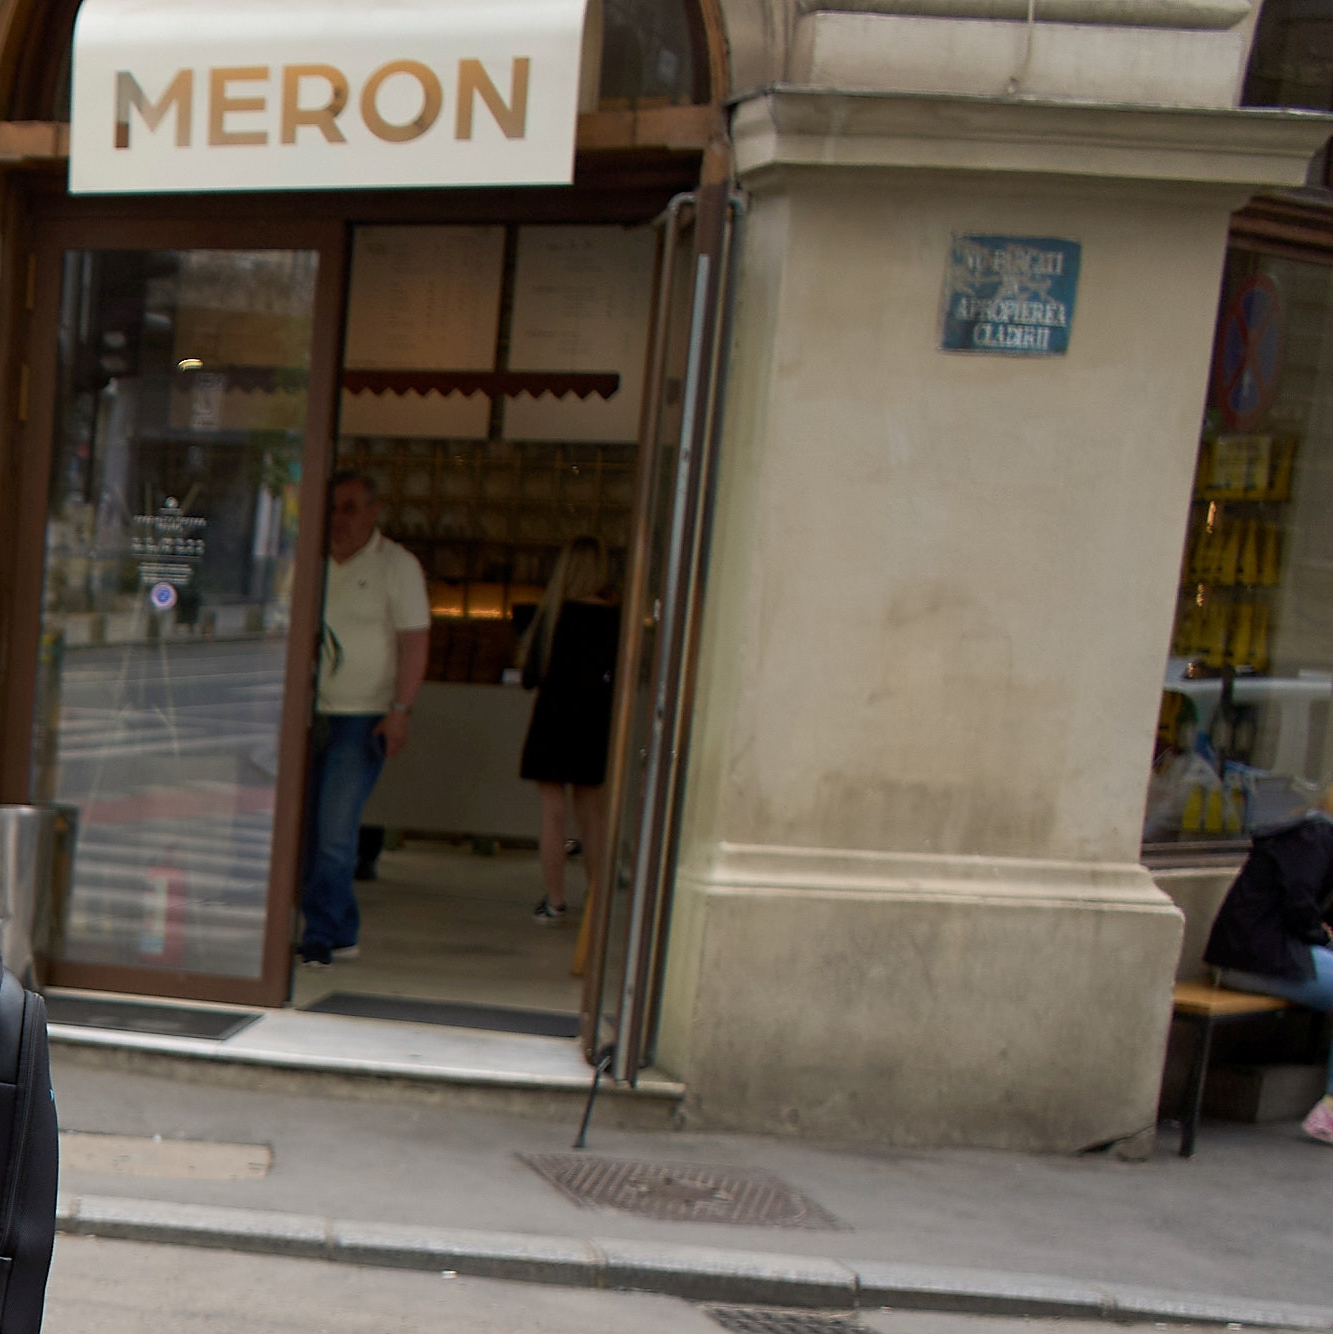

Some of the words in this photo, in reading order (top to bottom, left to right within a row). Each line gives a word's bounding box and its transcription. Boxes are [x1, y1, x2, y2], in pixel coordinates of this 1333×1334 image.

[113, 57, 531, 150] MERON
[956, 297, 1068, 326] APROPIEREA
[973, 322, 1052, 348] CLADIRII
